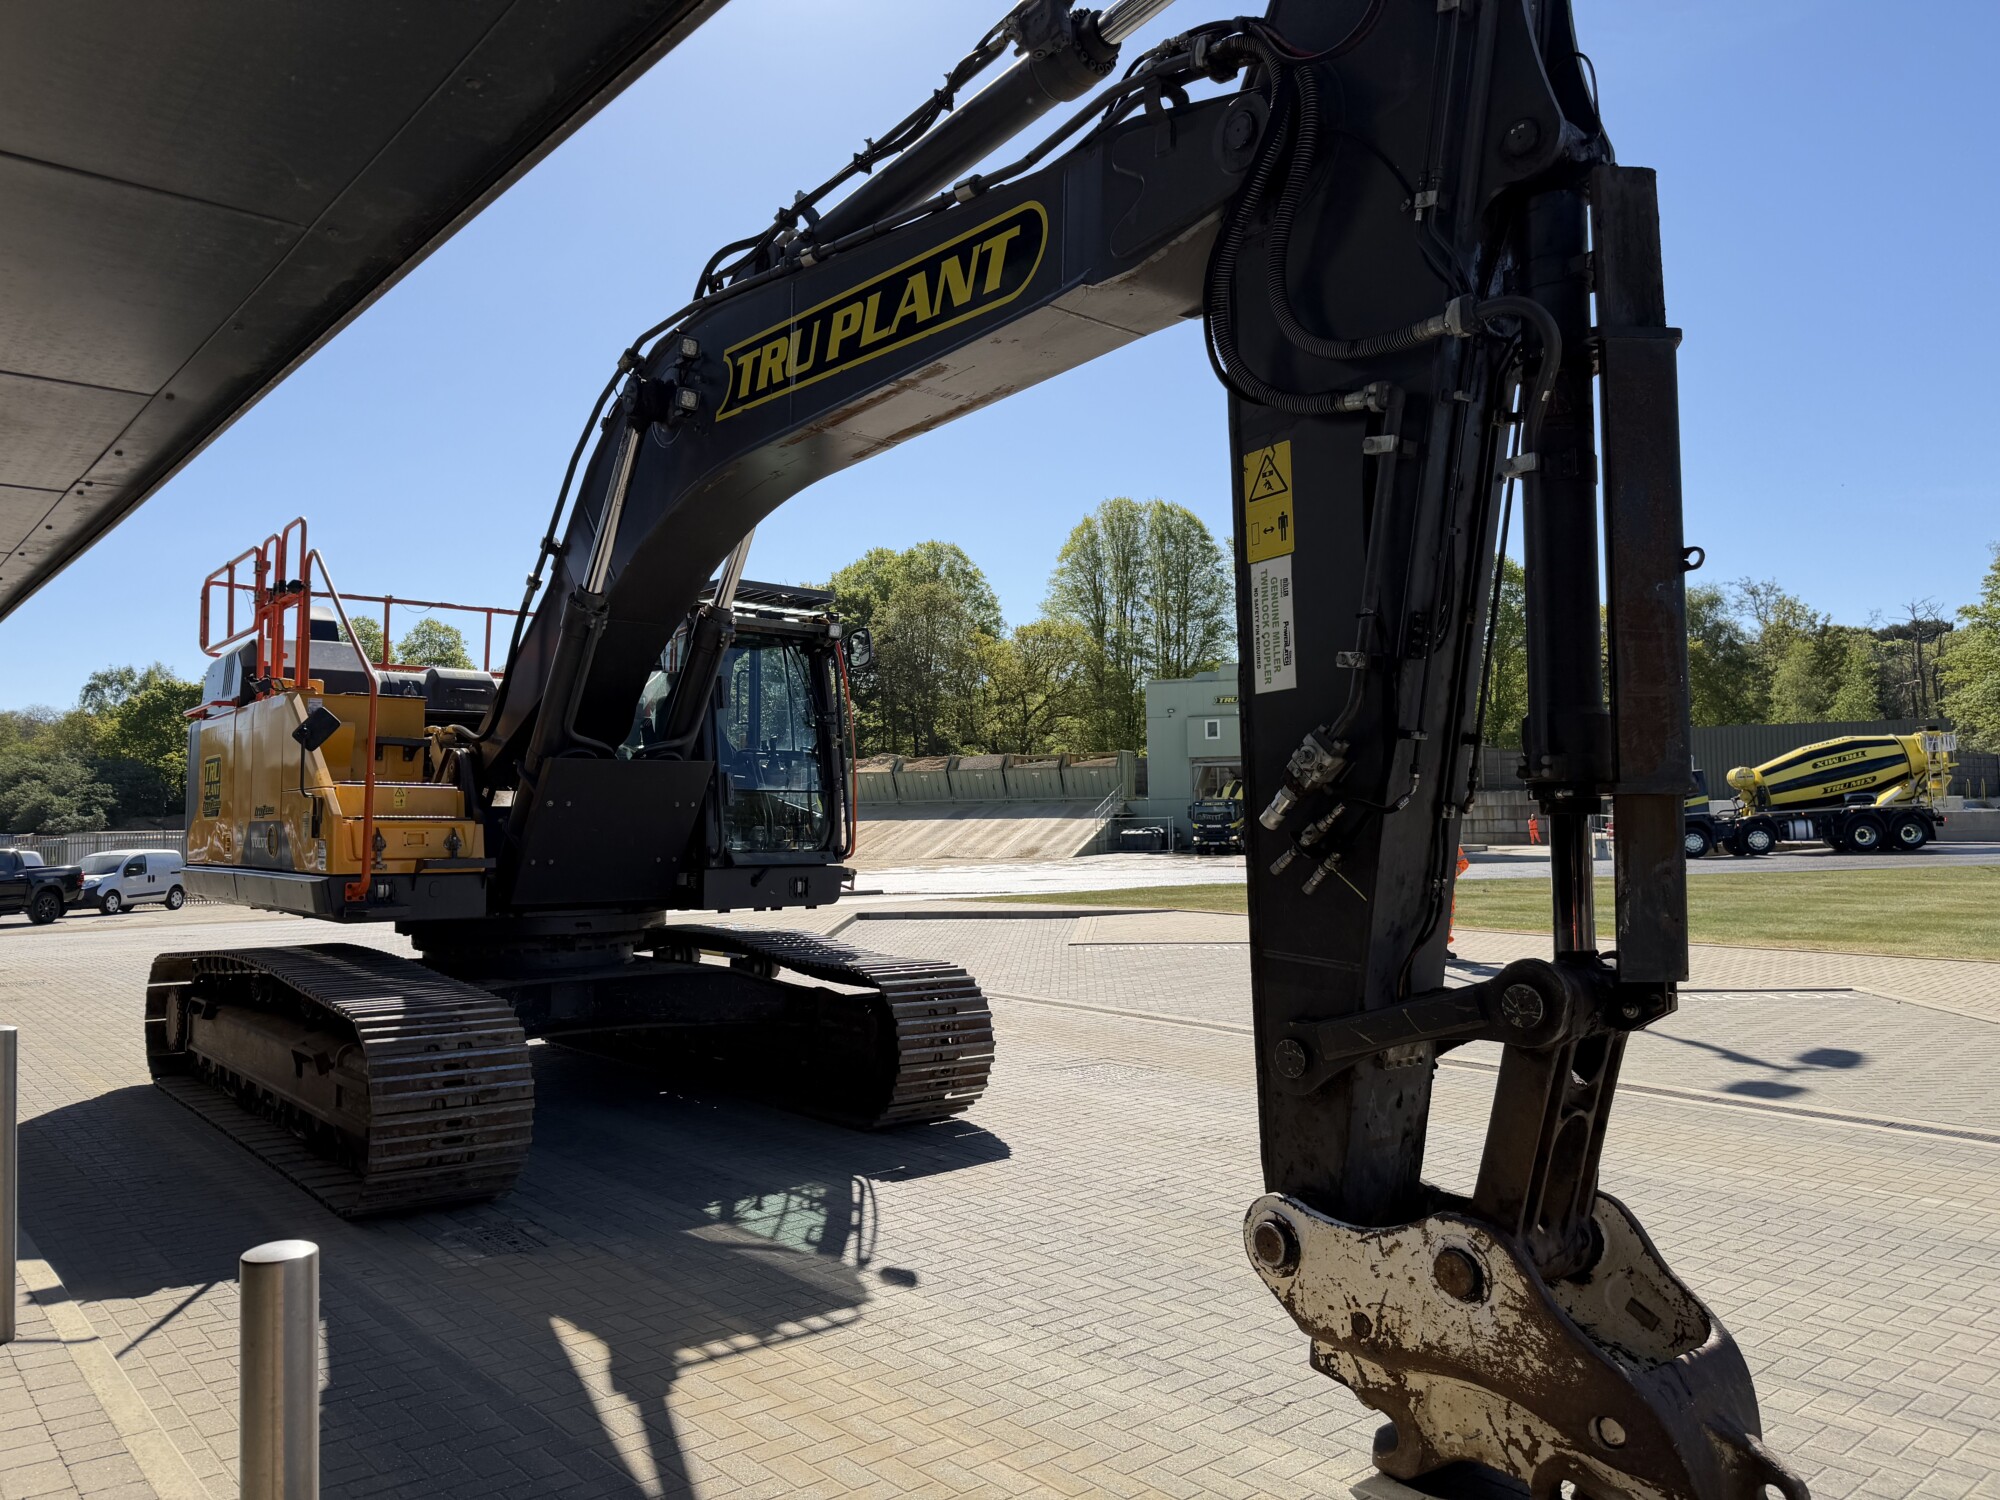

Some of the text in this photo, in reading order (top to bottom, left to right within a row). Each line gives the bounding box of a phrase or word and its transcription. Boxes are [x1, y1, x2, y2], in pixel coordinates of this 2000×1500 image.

[736, 224, 1021, 399] TRU PLANT
[1253, 587, 1259, 598] NO
[1260, 568, 1272, 685] TWINLOCK COUPLER
[1270, 576, 1282, 673] GENUINE MILLER
[205, 761, 220, 782] TRU
[205, 783, 220, 796] PLANT
[1826, 776, 1874, 793] TRU MIX
